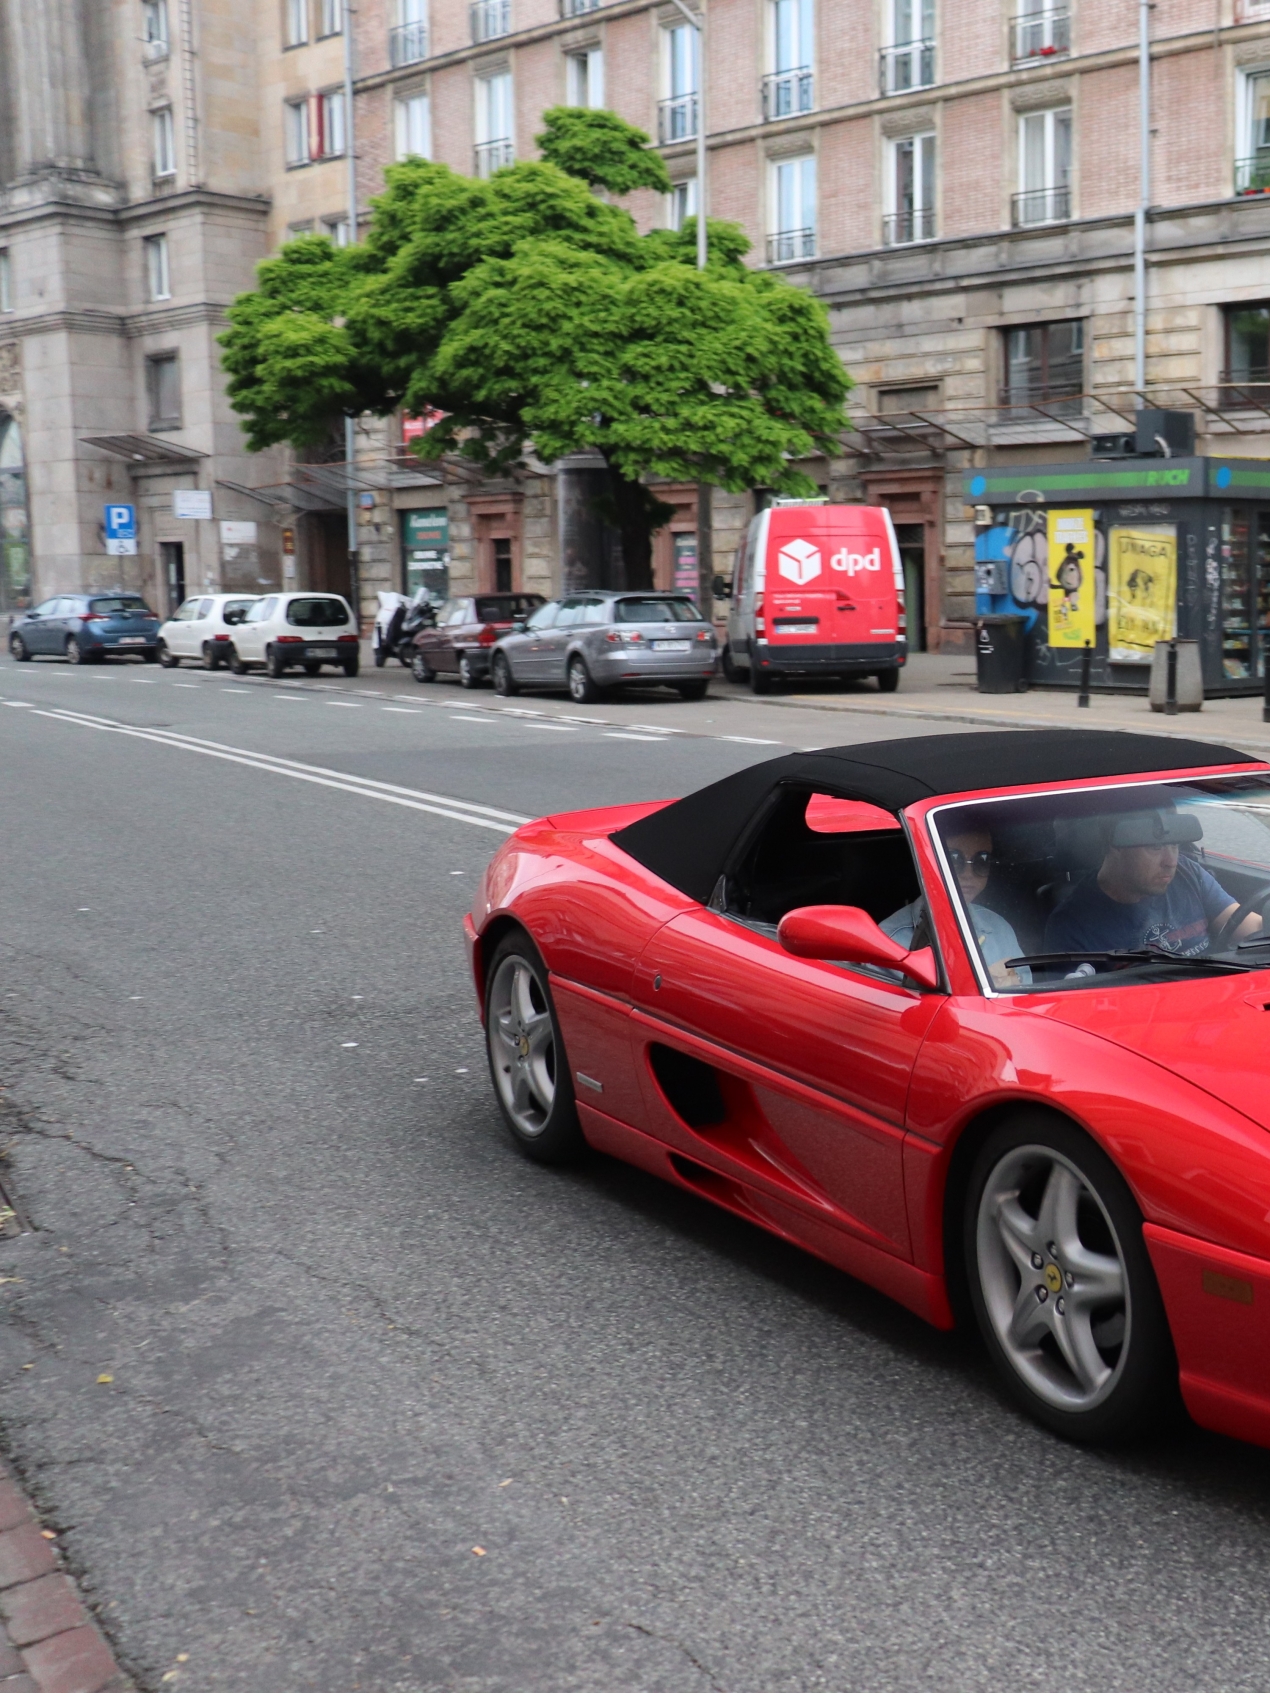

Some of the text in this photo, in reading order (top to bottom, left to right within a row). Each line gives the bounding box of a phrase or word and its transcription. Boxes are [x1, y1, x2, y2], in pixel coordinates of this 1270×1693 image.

[1147, 468, 1190, 486] RUCH
[109, 507, 130, 530] P
[829, 547, 881, 577] dpd
